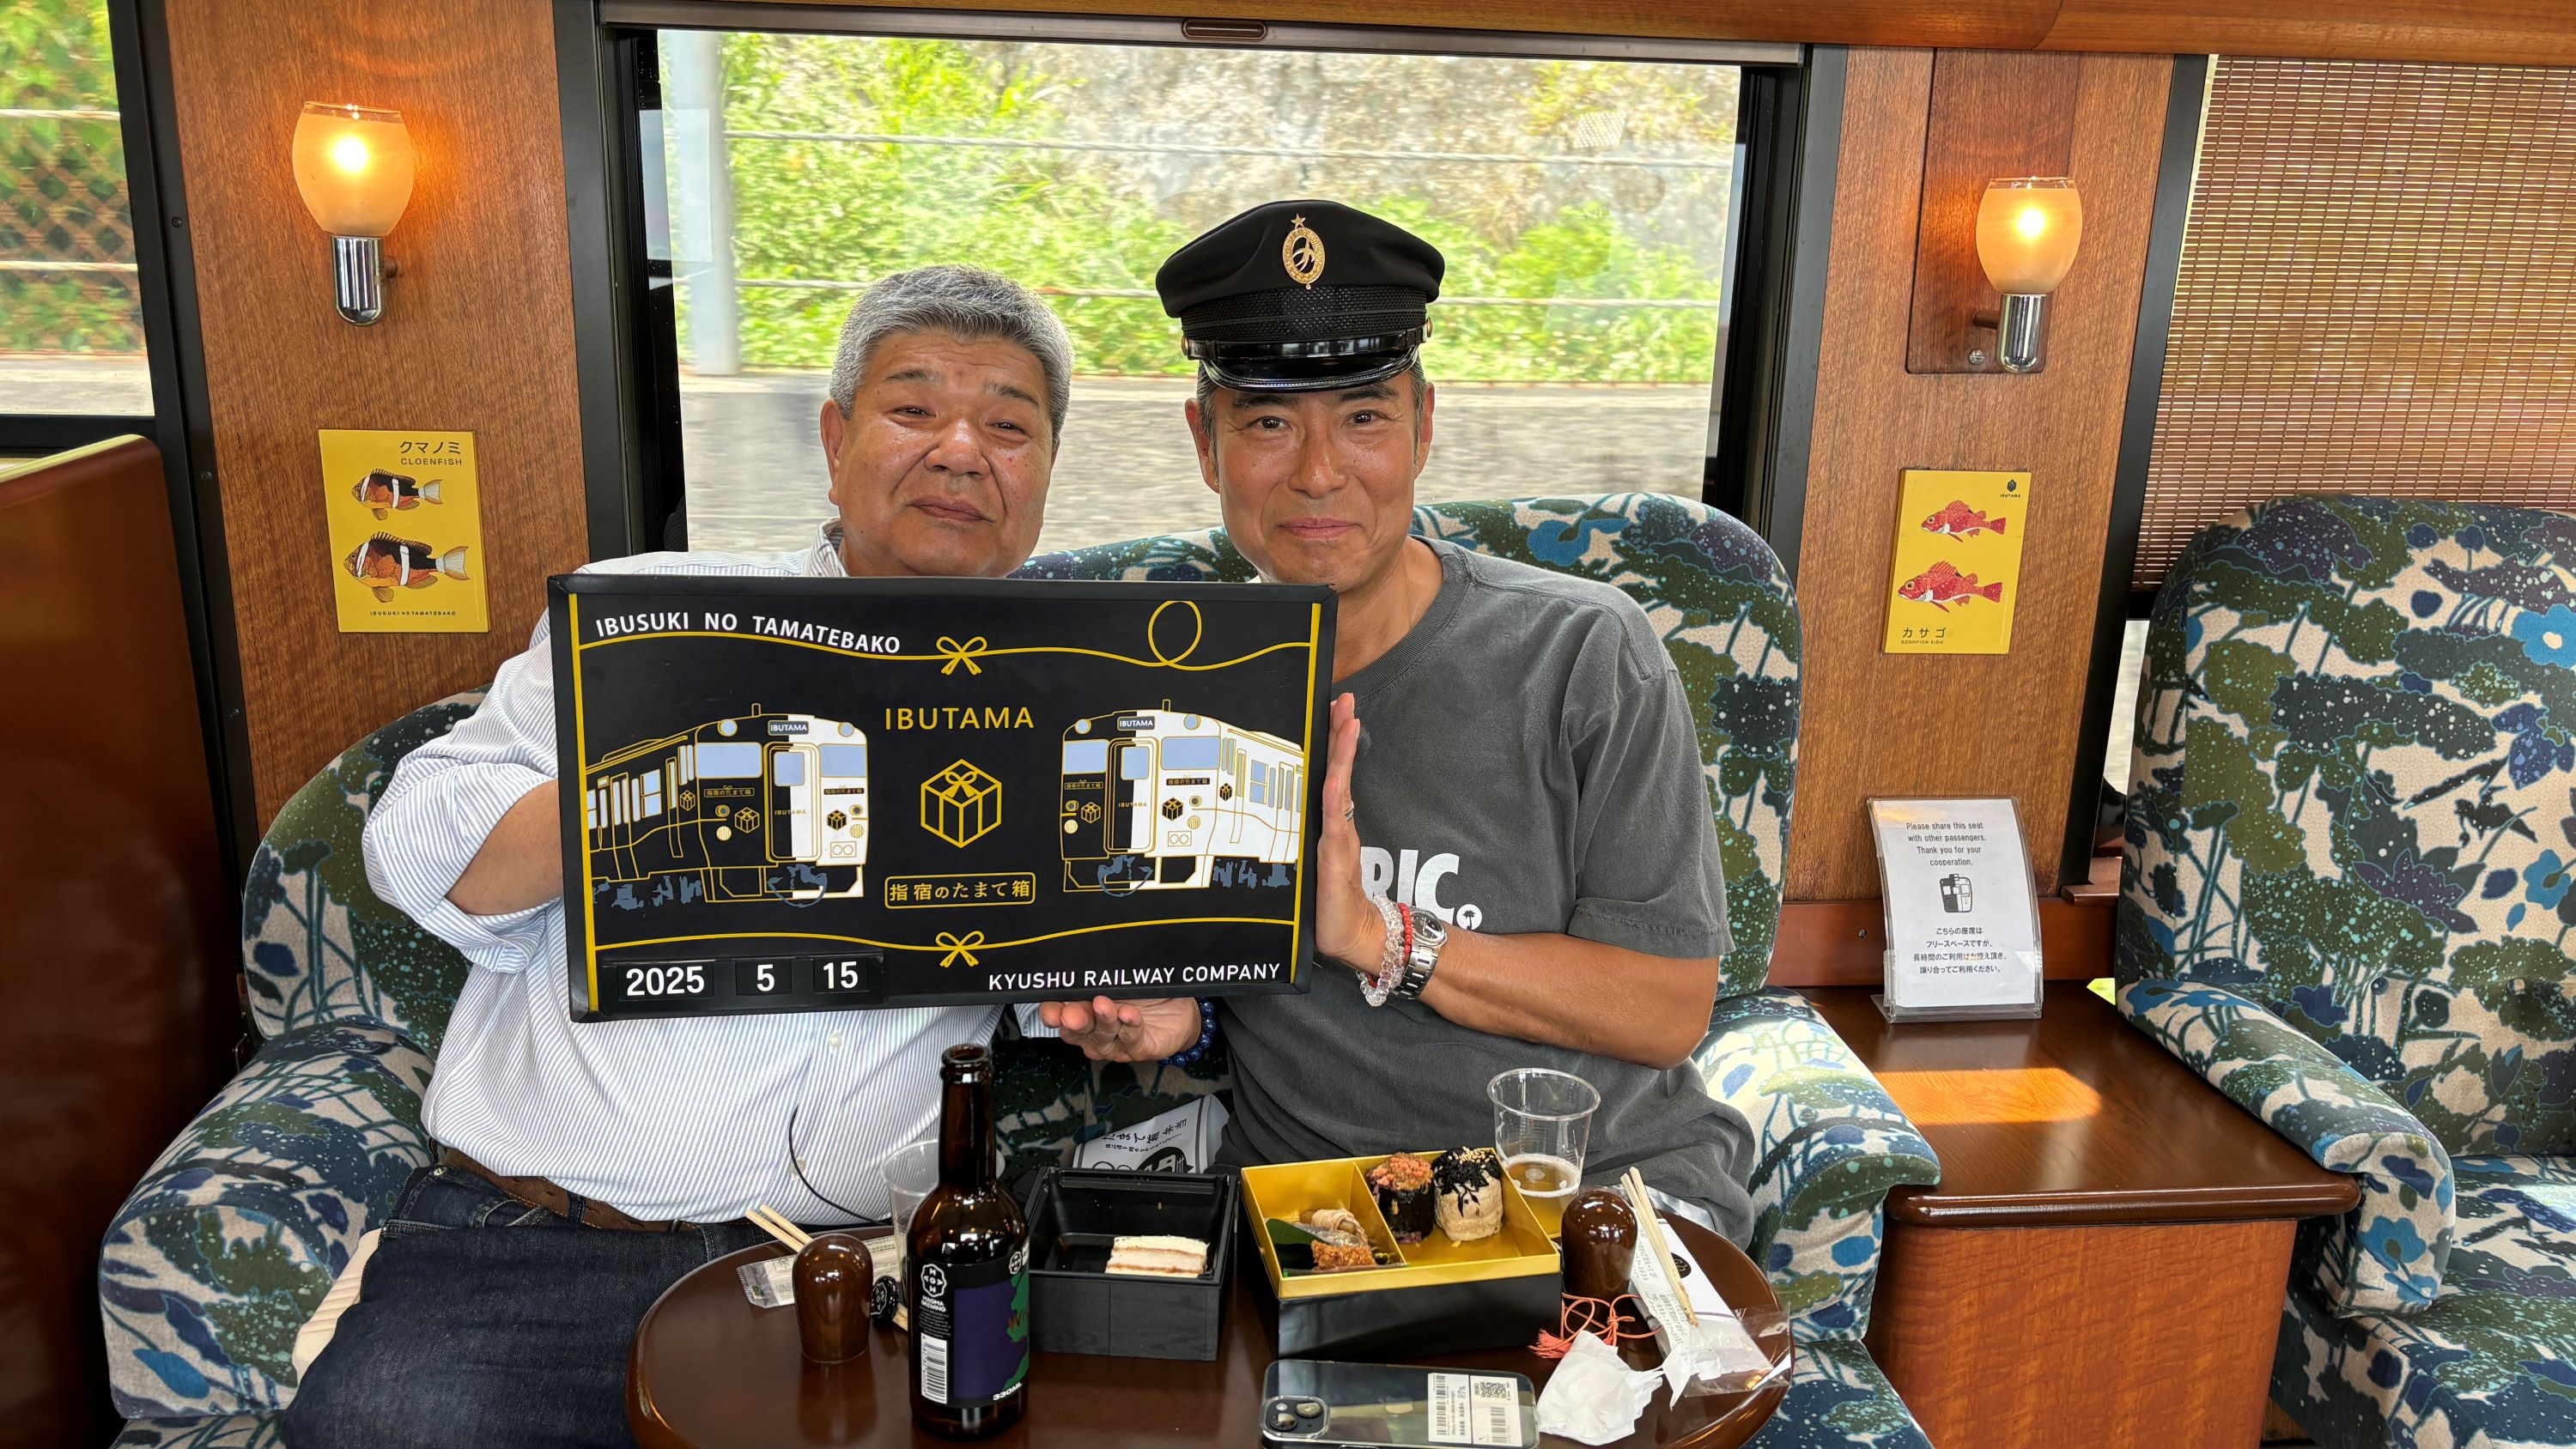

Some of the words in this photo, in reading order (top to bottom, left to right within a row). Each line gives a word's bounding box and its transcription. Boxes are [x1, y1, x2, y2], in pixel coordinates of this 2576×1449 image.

[399, 440, 461, 454] クマノミ
[595, 611, 690, 638] IBUSUKI
[704, 612, 738, 631] NO
[752, 615, 900, 654] TAMATEBAKO
[1902, 627, 1947, 639] カサゴ
[884, 706, 1035, 731] IBUTAMA
[1931, 822, 1951, 830] share
[1916, 846, 1938, 854] Thank
[889, 879, 1031, 902] 指宿のたまて箱
[1935, 926, 1983, 936] こちらの座席は
[625, 966, 705, 997] 2025
[756, 963, 775, 992] 5
[823, 961, 859, 990] 15
[988, 971, 1075, 991] KYUSHU
[1084, 967, 1176, 987] RAILWAY
[1182, 963, 1280, 983] COMPANY
[993, 1381, 1022, 1401] 330ML
